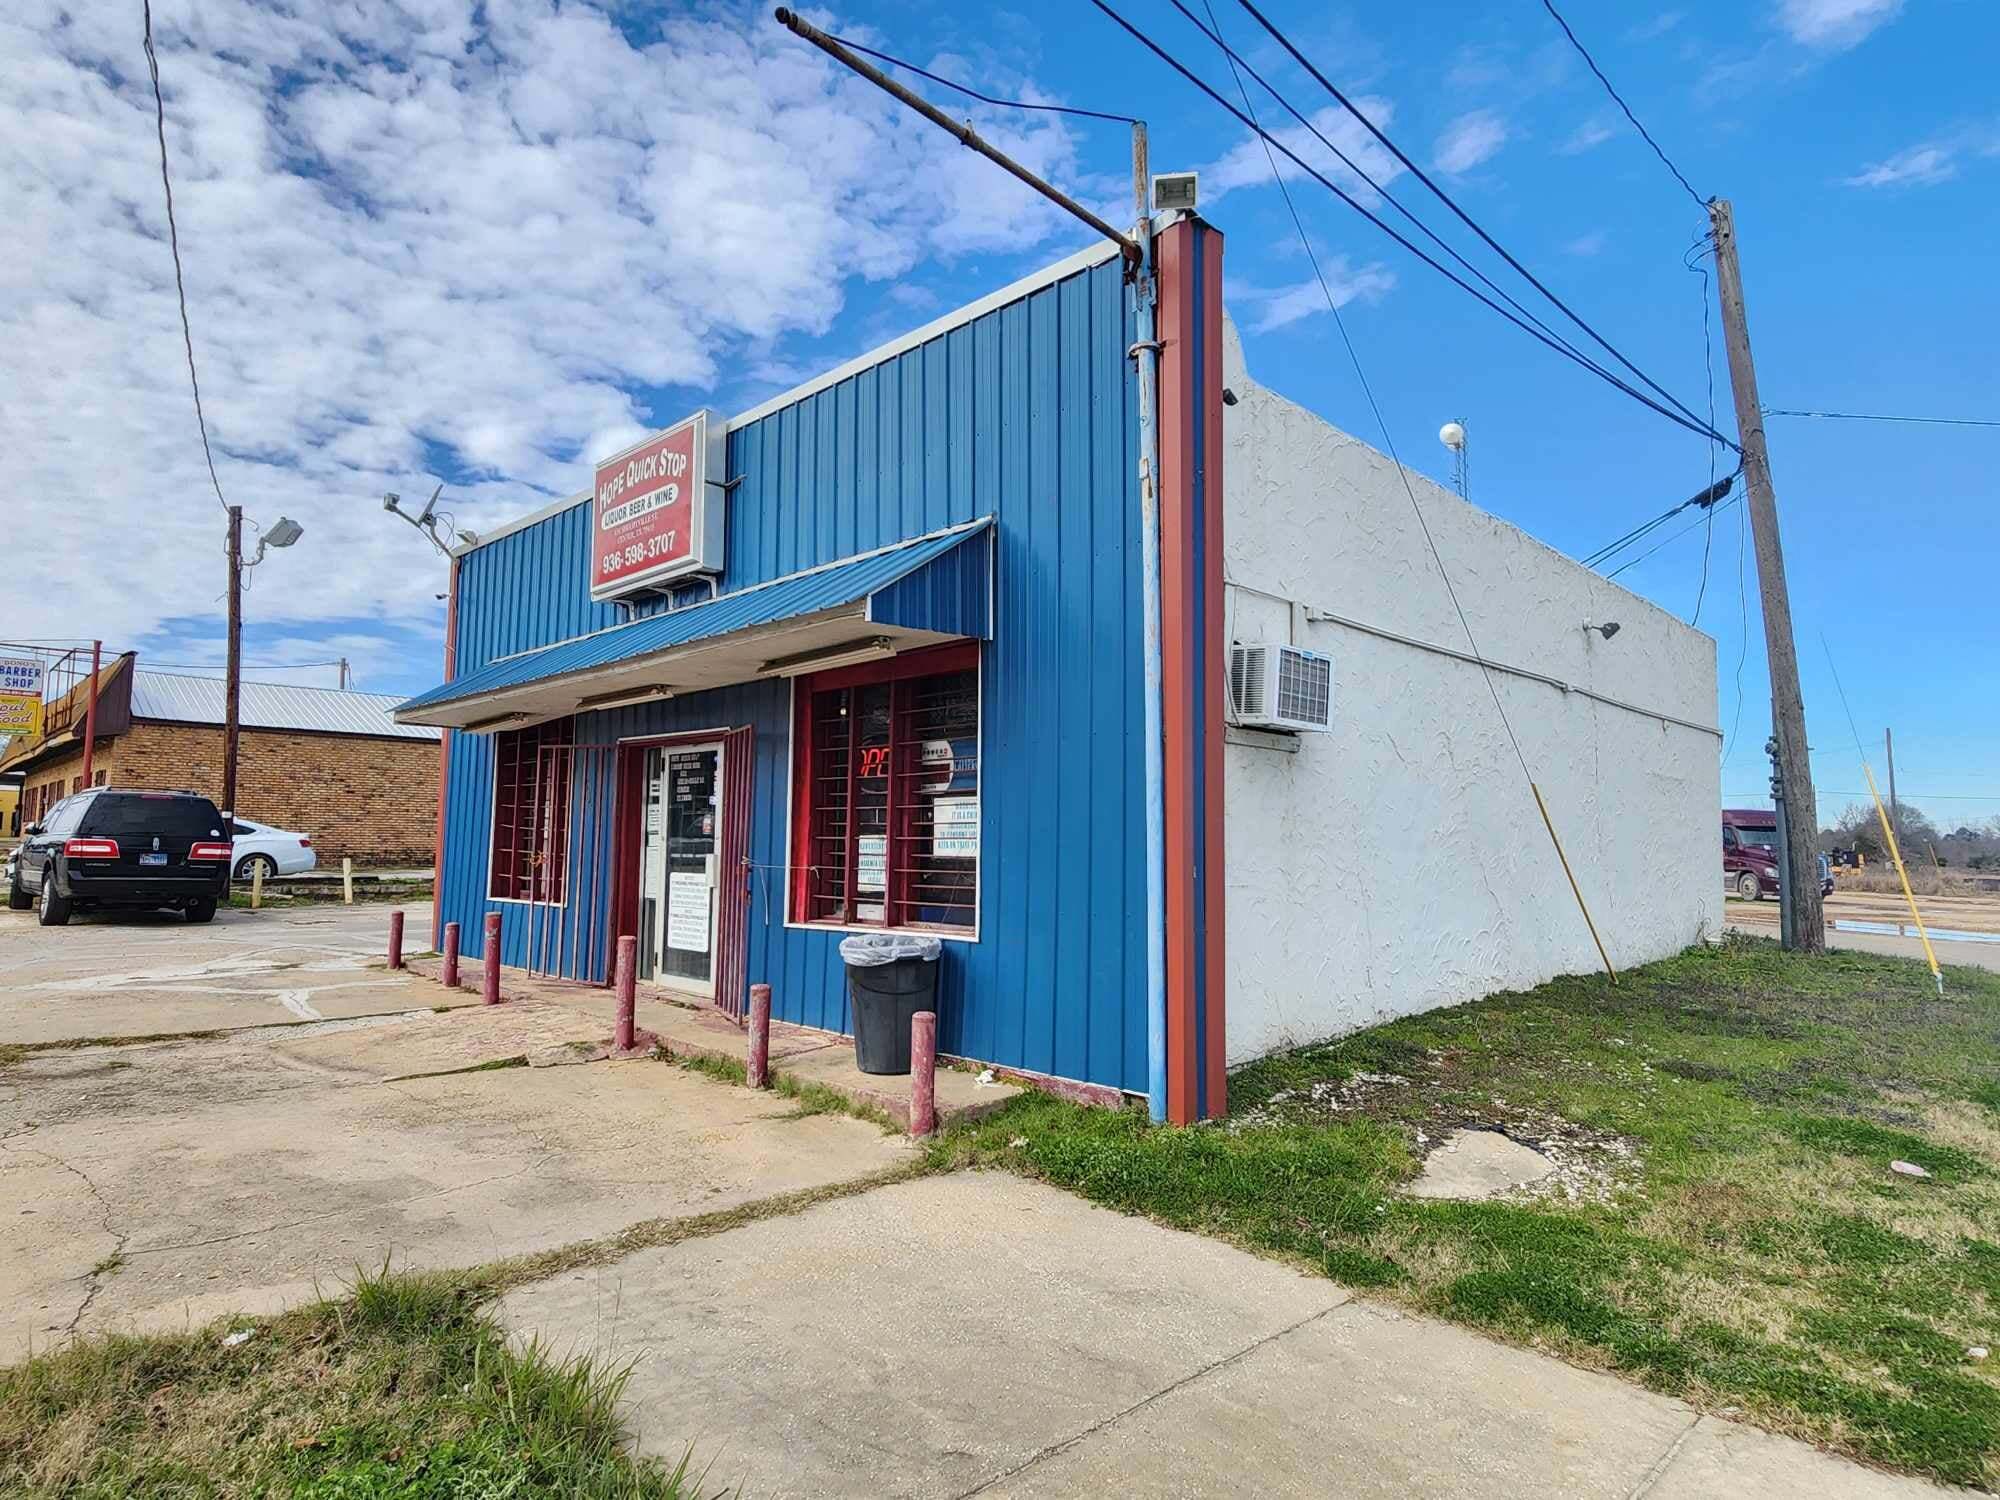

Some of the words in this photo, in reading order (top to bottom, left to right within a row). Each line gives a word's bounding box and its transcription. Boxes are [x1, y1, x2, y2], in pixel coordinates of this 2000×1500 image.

[599, 470, 625, 512] HOPE
[626, 454, 658, 488] QUICK
[659, 448, 687, 478] STOP
[604, 506, 627, 527] LIQUOR
[629, 498, 646, 516] BEER
[647, 497, 653, 511] &
[654, 487, 673, 508] WINE
[0, 665, 41, 678] BARBER
[5, 677, 34, 688] SHOP
[0, 699, 26, 711] oul
